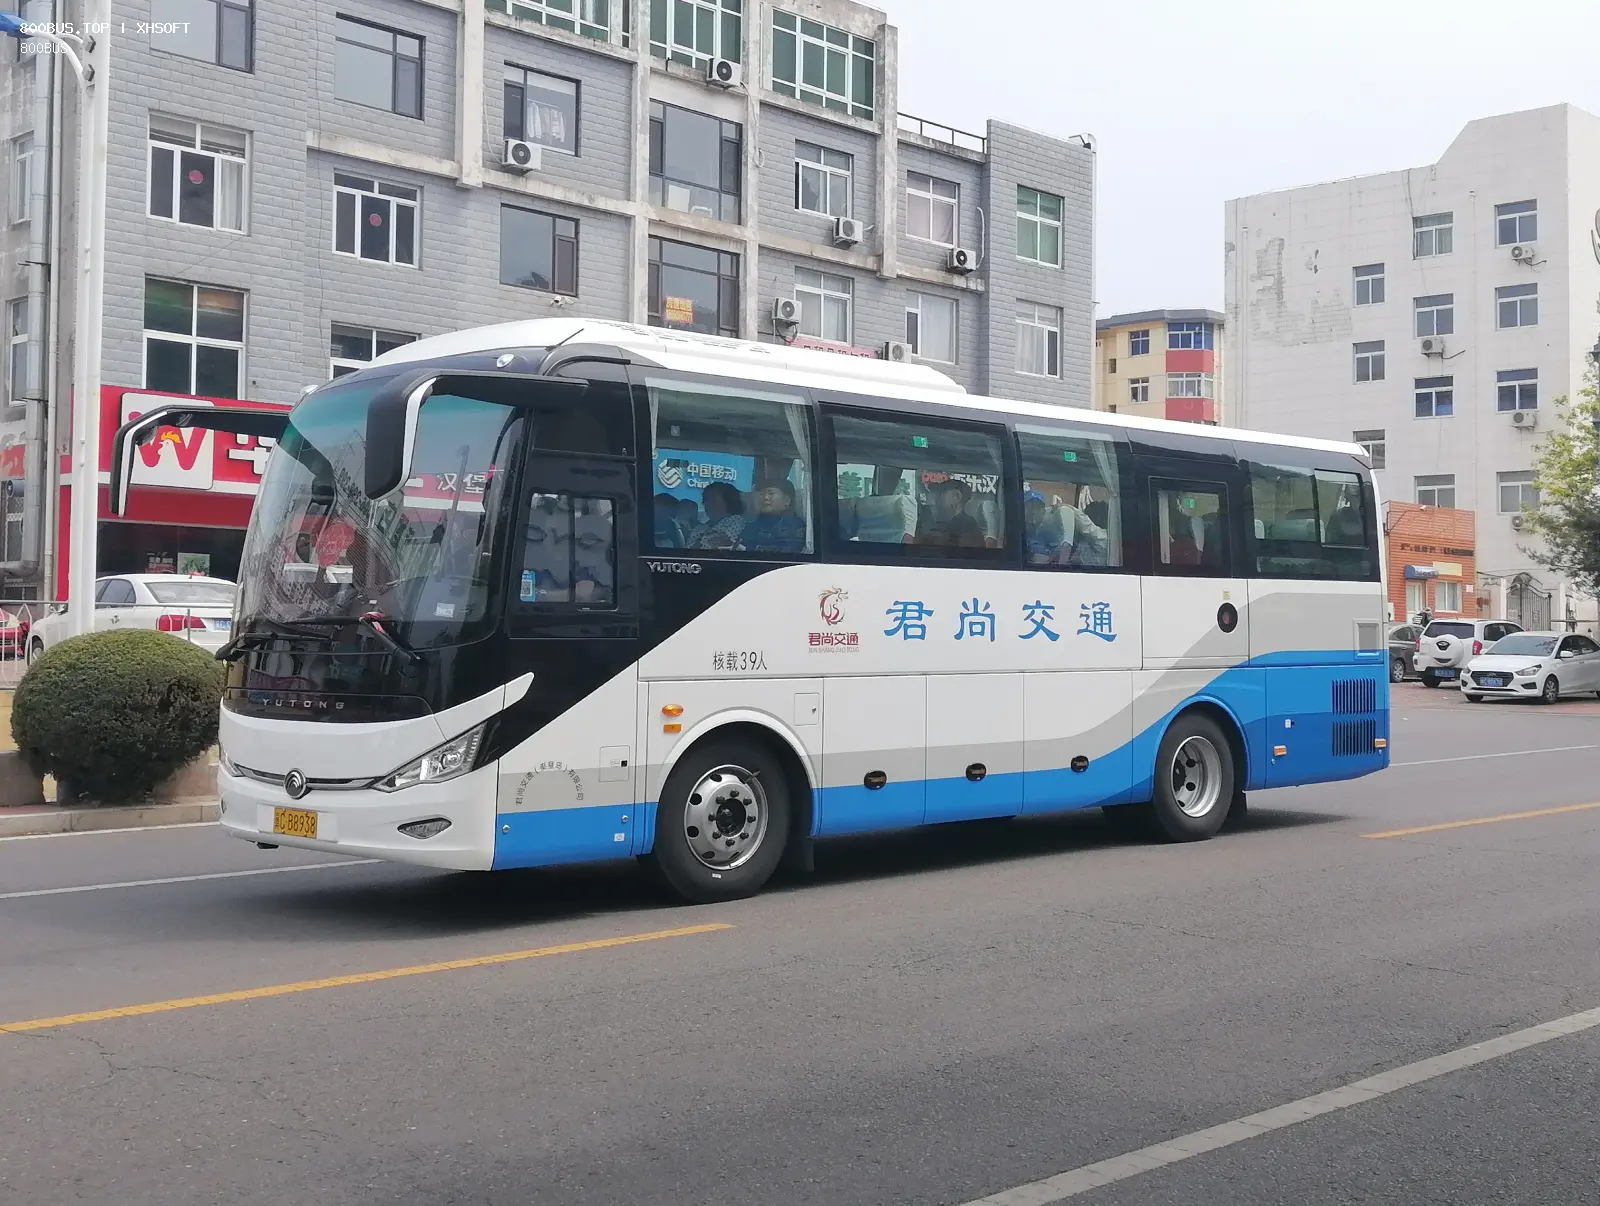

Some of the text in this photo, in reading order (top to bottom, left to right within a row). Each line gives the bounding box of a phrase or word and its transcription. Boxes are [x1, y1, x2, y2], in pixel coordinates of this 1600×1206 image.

[687, 462, 737, 480] 中国移动
[436, 472, 487, 493] 汉堡
[646, 561, 702, 574] YUTONG
[884, 598, 1118, 643] 君尚交通
[808, 632, 859, 646] 君尚交通
[712, 651, 768, 671] 核载39人
[262, 698, 346, 710] YUTONG
